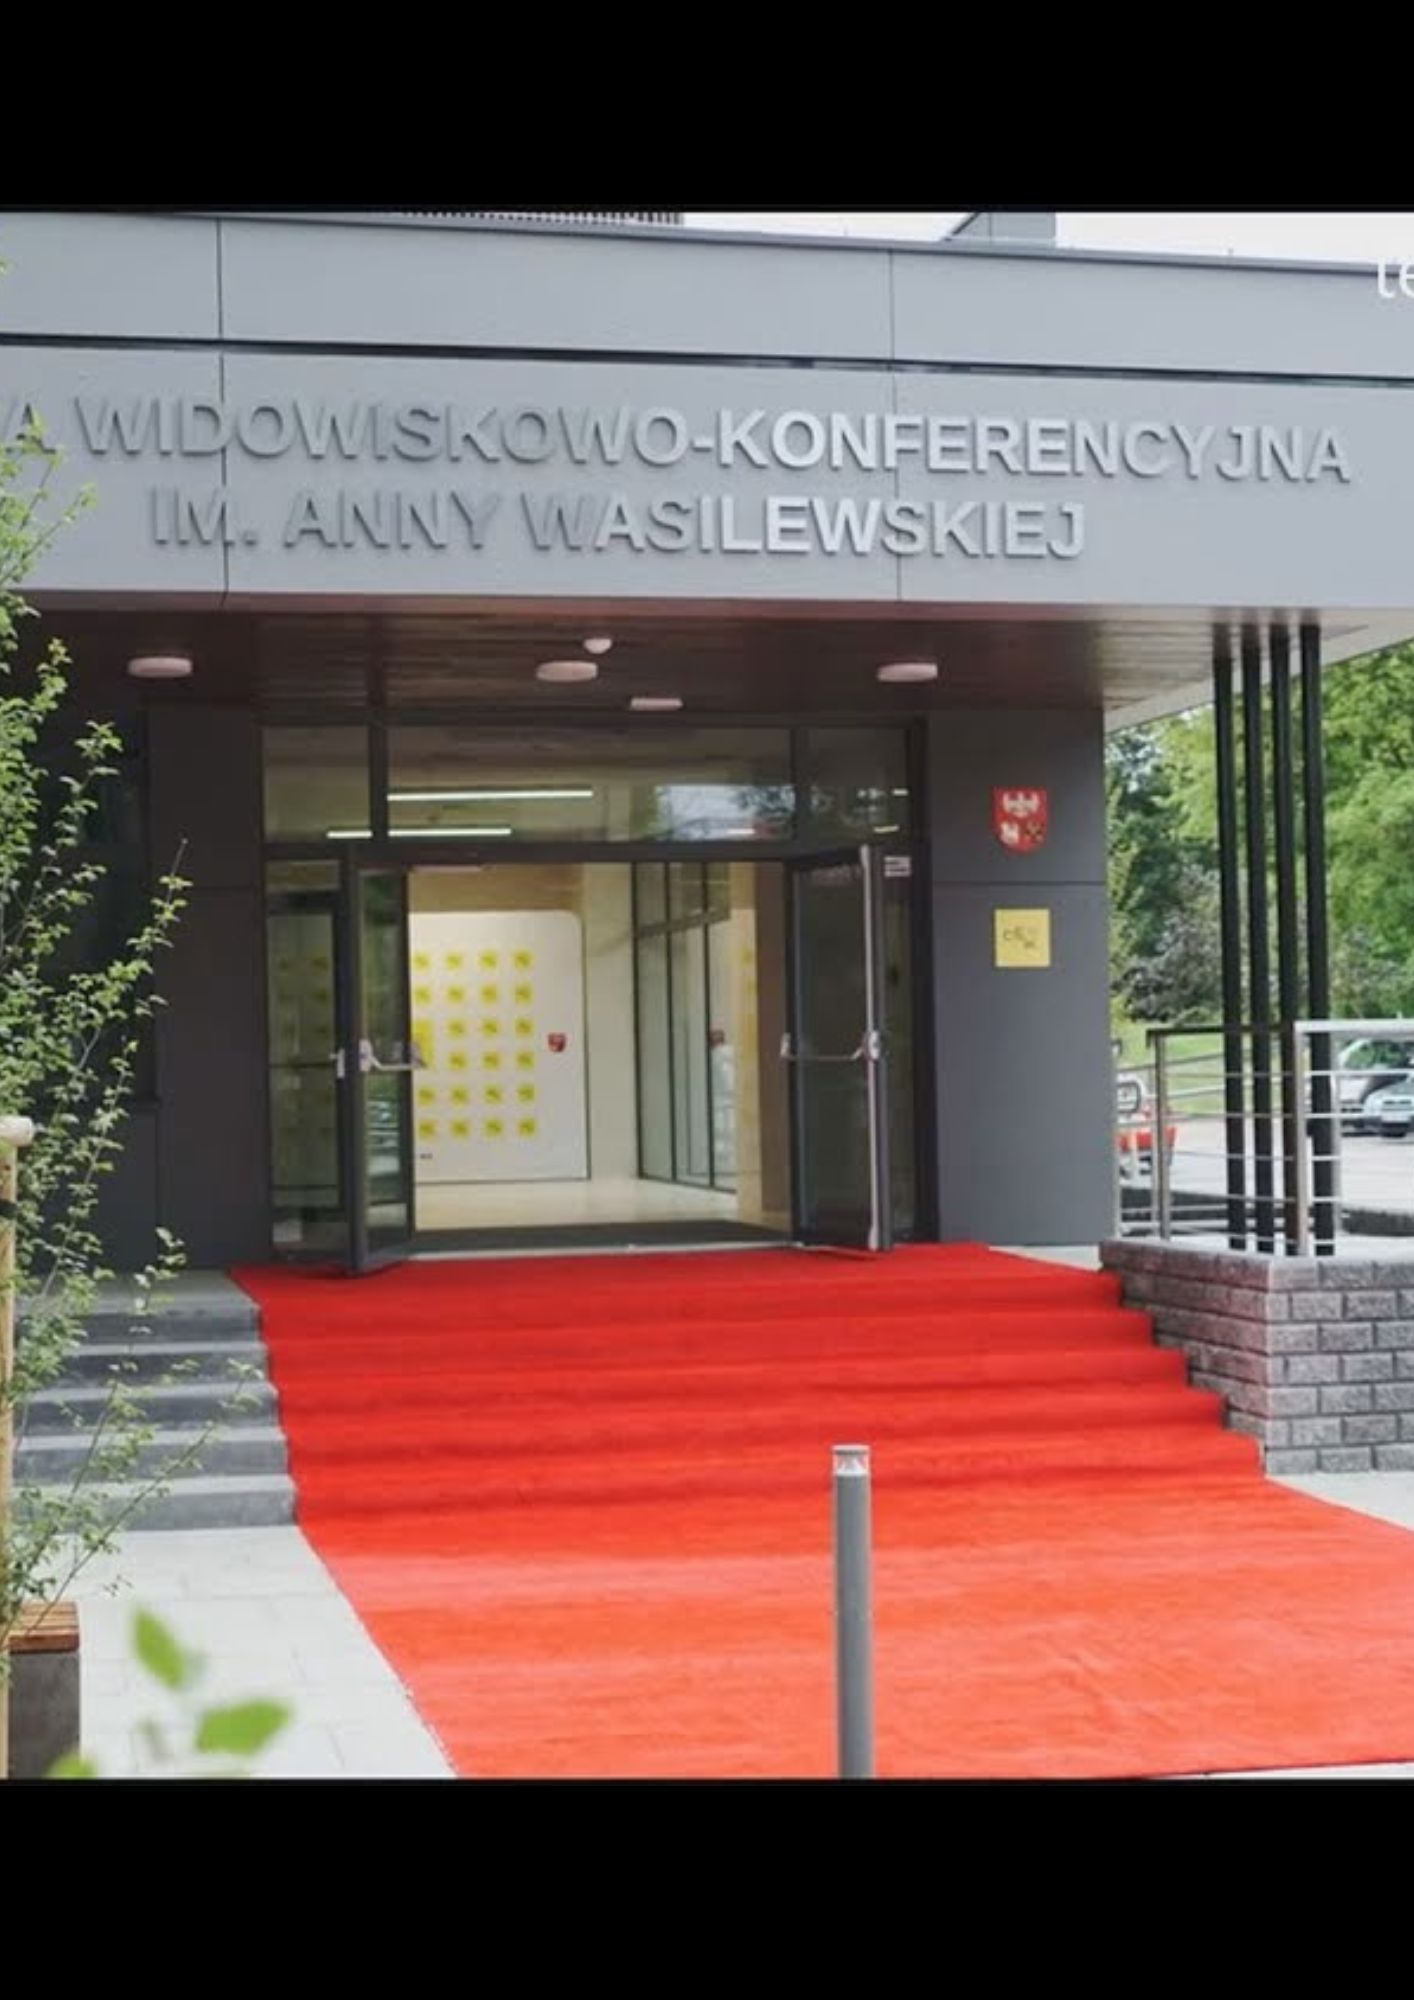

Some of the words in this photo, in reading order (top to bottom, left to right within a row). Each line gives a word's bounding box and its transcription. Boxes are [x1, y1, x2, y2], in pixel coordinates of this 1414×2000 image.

[73, 396, 1352, 483] WIDOWISKOWO-KONFERENCYJNA
[150, 487, 260, 548] IM.
[281, 490, 496, 551] ANNY
[520, 491, 1087, 560] WASILEWSKIEJ
